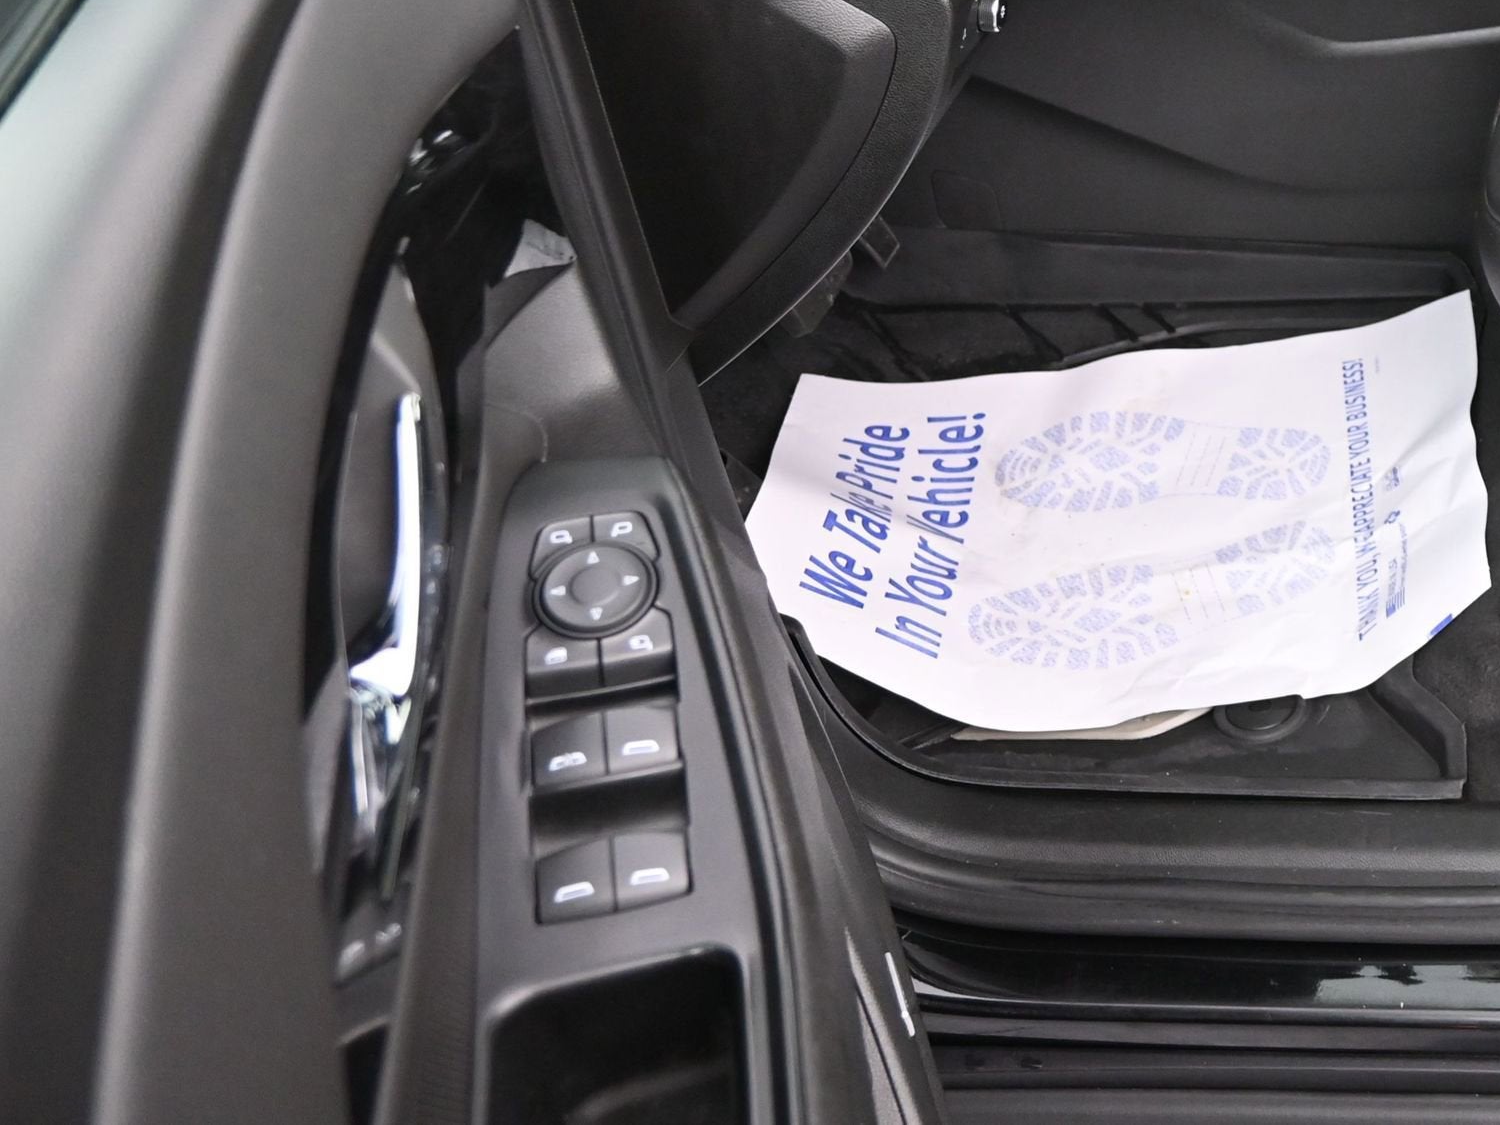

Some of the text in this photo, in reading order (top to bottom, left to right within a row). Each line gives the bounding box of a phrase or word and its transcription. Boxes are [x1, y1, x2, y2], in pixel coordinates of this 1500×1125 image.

[1342, 358, 1367, 422] BUSINESS!
[1347, 421, 1370, 460] YOUR
[799, 424, 910, 609] We Take Pride
[1350, 457, 1376, 534] APPRECIATE
[875, 412, 986, 659] In Your Vehicle!
[1356, 553, 1381, 592] YOU,
[1357, 587, 1380, 641] THANK
